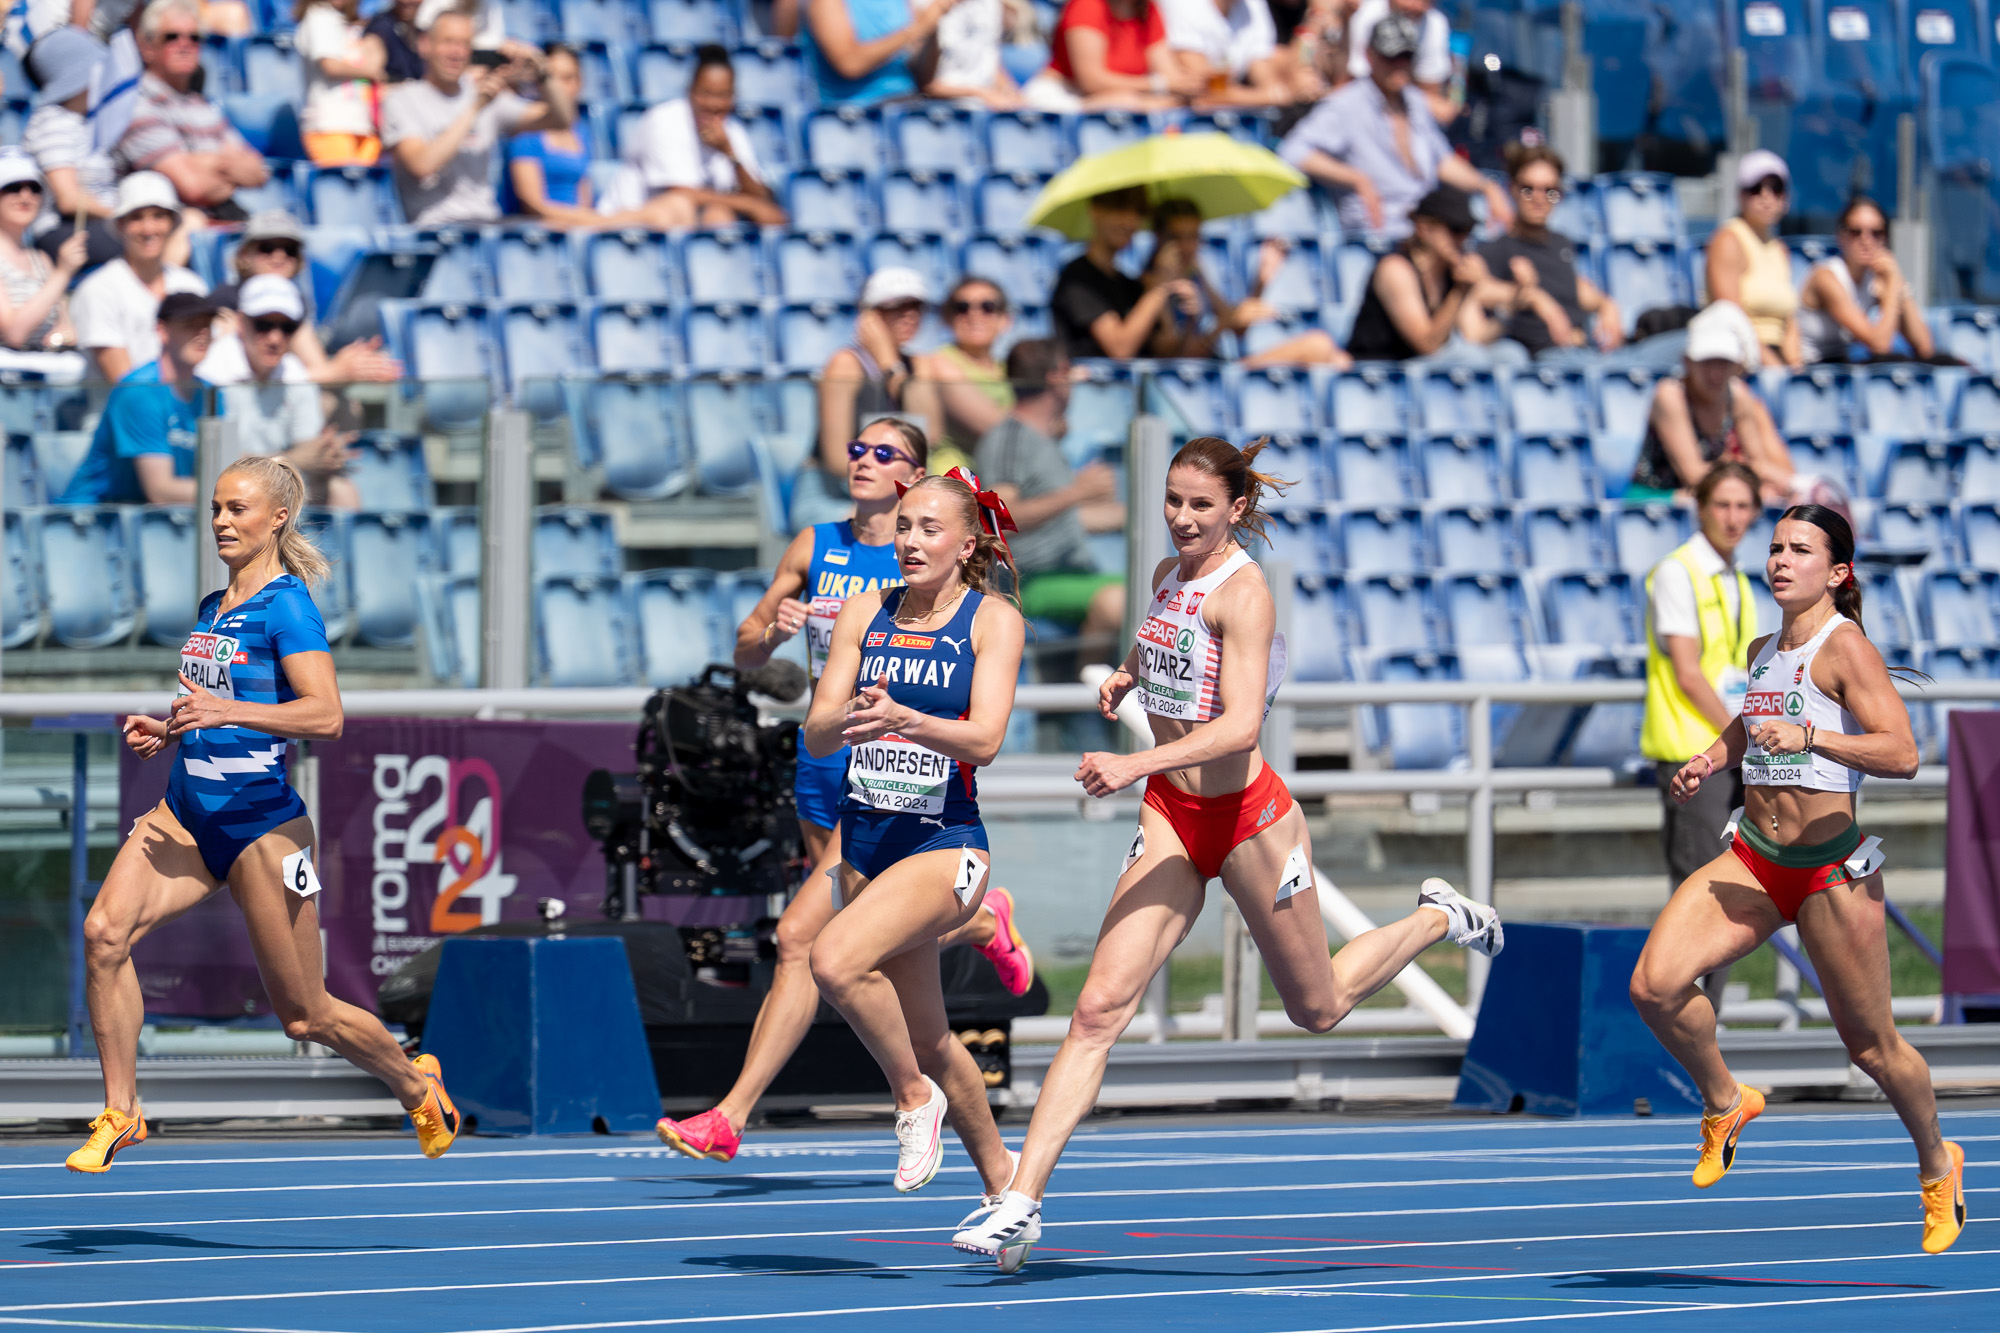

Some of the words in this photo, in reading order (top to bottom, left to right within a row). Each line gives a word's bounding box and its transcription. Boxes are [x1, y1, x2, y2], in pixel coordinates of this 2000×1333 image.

[814, 601, 842, 616] SP
[906, 638, 931, 647] EXTRA
[1140, 618, 1177, 646] SPAR
[183, 636, 215, 657] SPAR
[182, 661, 230, 691] ARALA
[859, 655, 957, 689] NORWAY
[1158, 699, 1183, 715] 2024
[1743, 694, 1783, 714] SPAR
[853, 745, 945, 779] ANDRESEN
[1747, 768, 1770, 781] ROMA
[1771, 768, 1802, 781] 2024
[894, 795, 928, 810] 2024
[371, 754, 410, 932] roma
[295, 858, 307, 891] 6
